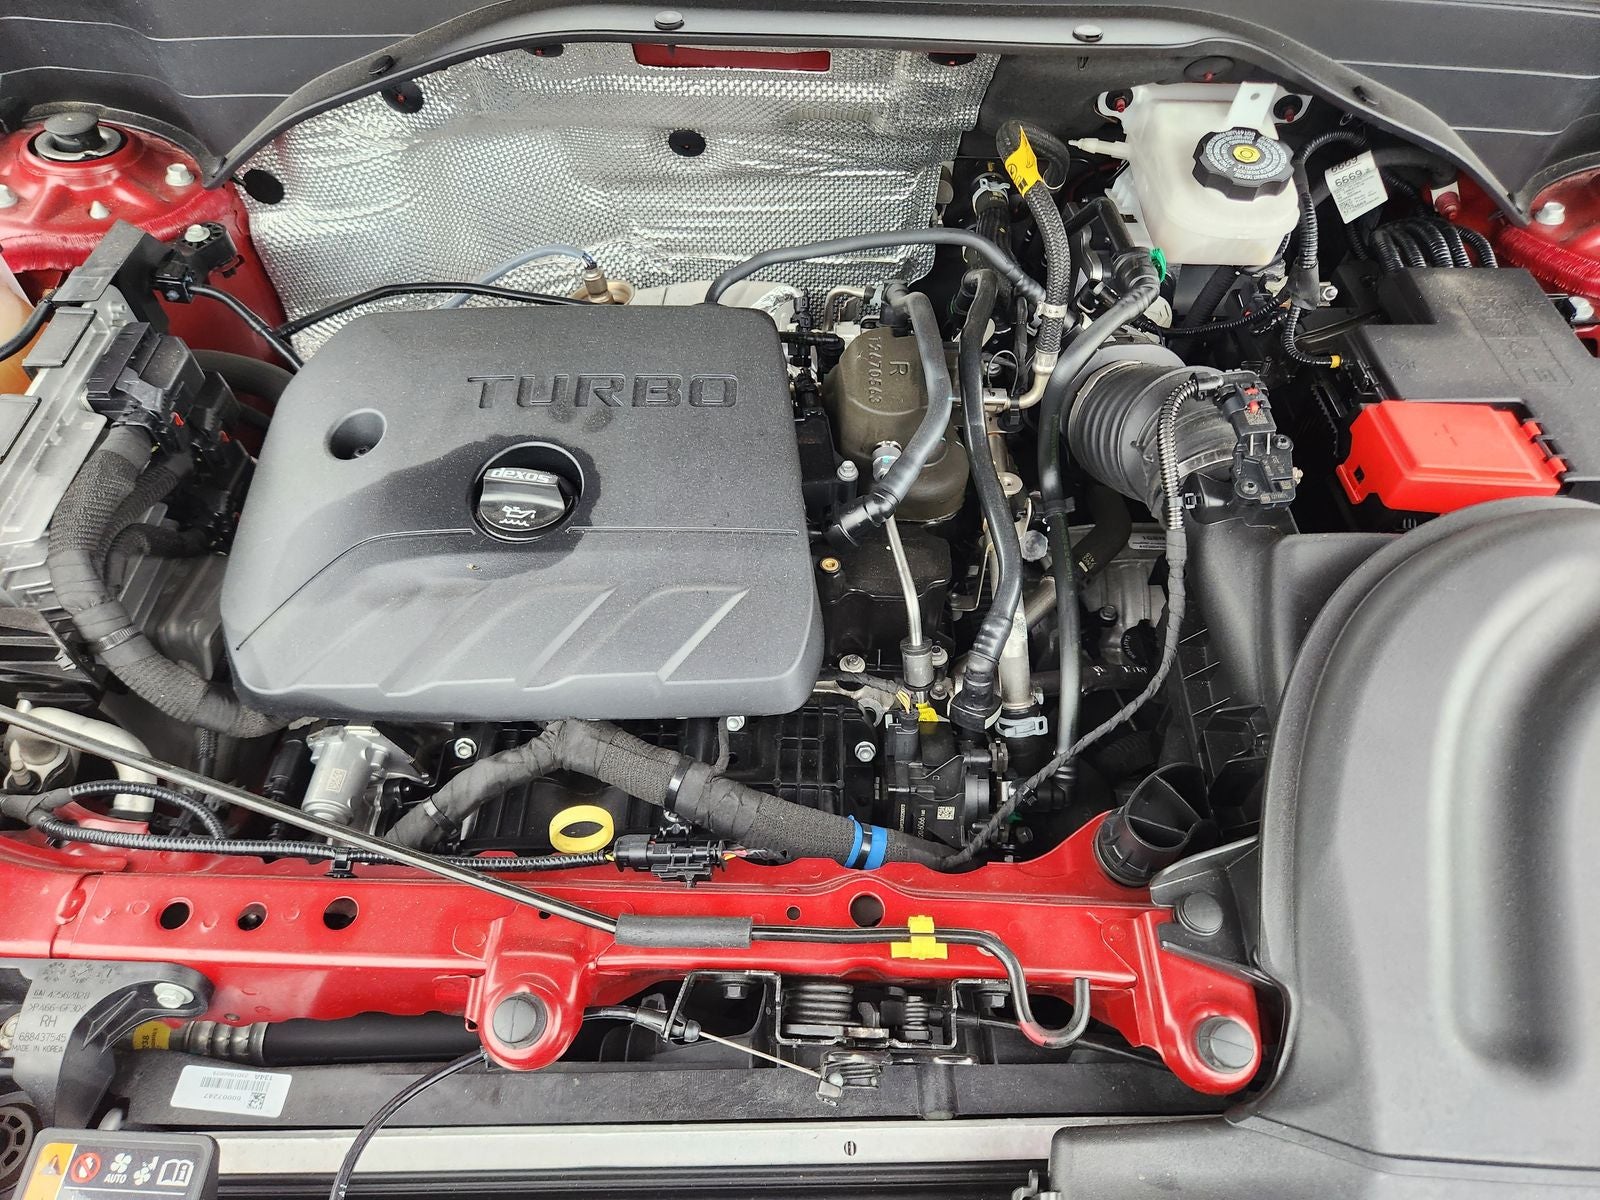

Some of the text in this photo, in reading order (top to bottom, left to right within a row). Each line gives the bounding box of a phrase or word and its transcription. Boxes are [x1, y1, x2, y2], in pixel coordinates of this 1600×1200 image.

[1335, 170, 1362, 186] 6669
[889, 361, 910, 376] R
[467, 373, 738, 409] TURBO
[490, 467, 551, 485] dexos
[39, 1014, 58, 1028] RH
[42, 1044, 64, 1053] KOREA
[104, 1173, 128, 1184] AUTO
